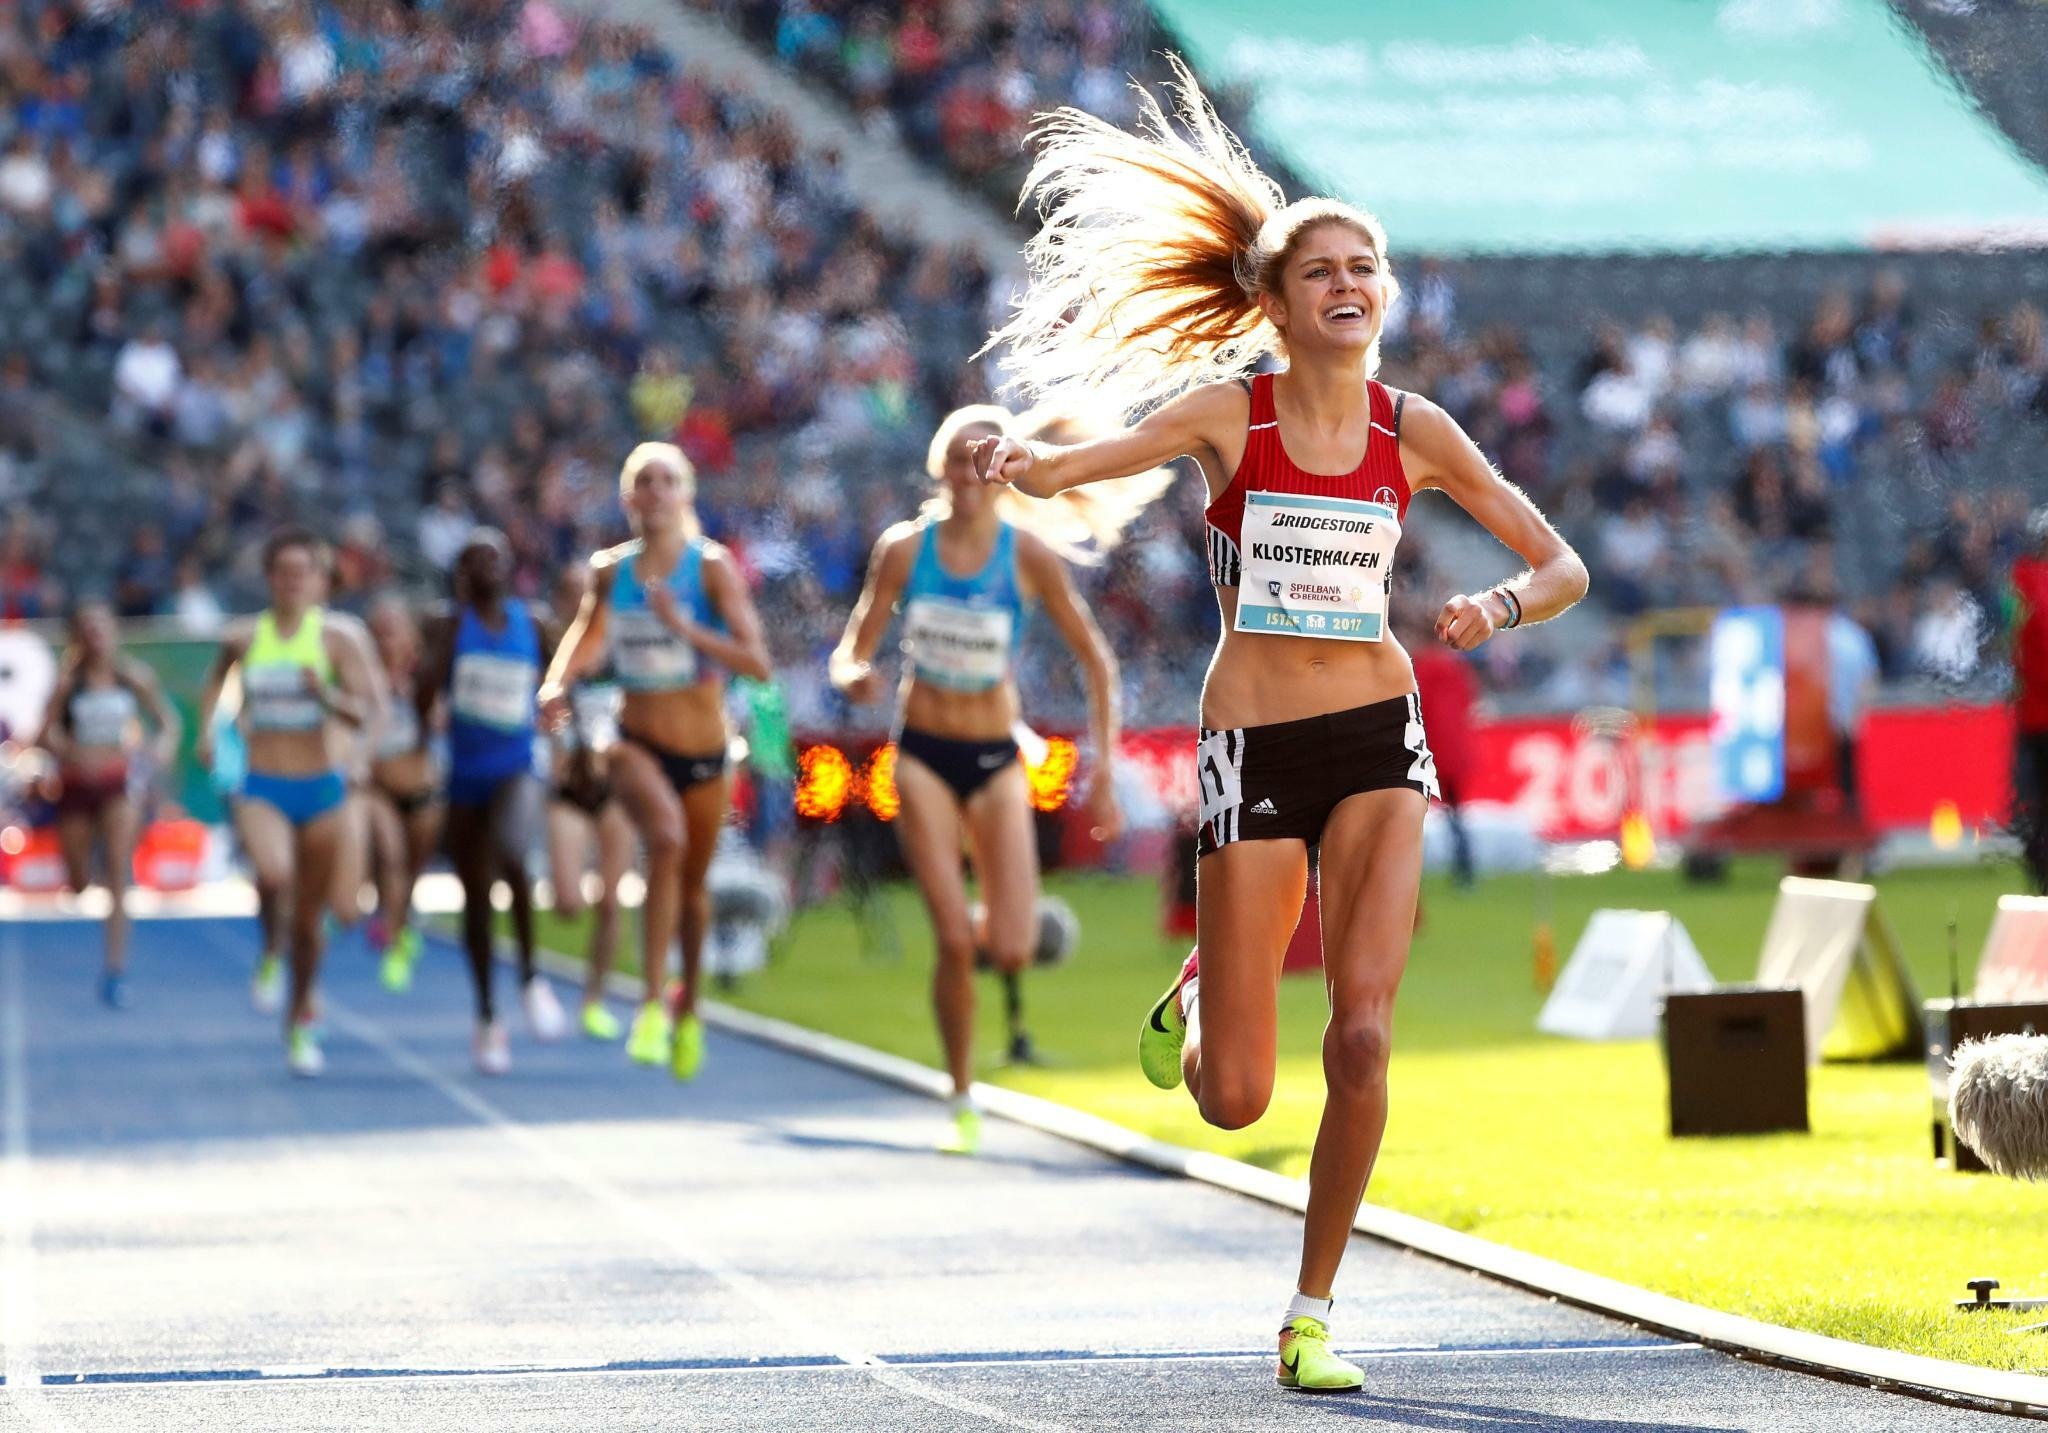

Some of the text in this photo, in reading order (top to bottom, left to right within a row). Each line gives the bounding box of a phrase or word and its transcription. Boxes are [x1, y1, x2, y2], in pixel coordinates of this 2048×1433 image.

[1271, 512, 1374, 535] BRIDGESTONE
[1252, 542, 1380, 569] KLOSTERHALFEN
[1290, 582, 1342, 595] SPIELBANK
[1302, 593, 1329, 602] BERLIN
[1266, 612, 1300, 627] ISTAF
[1332, 617, 1362, 631] 2017
[1250, 807, 1278, 815] adidas
